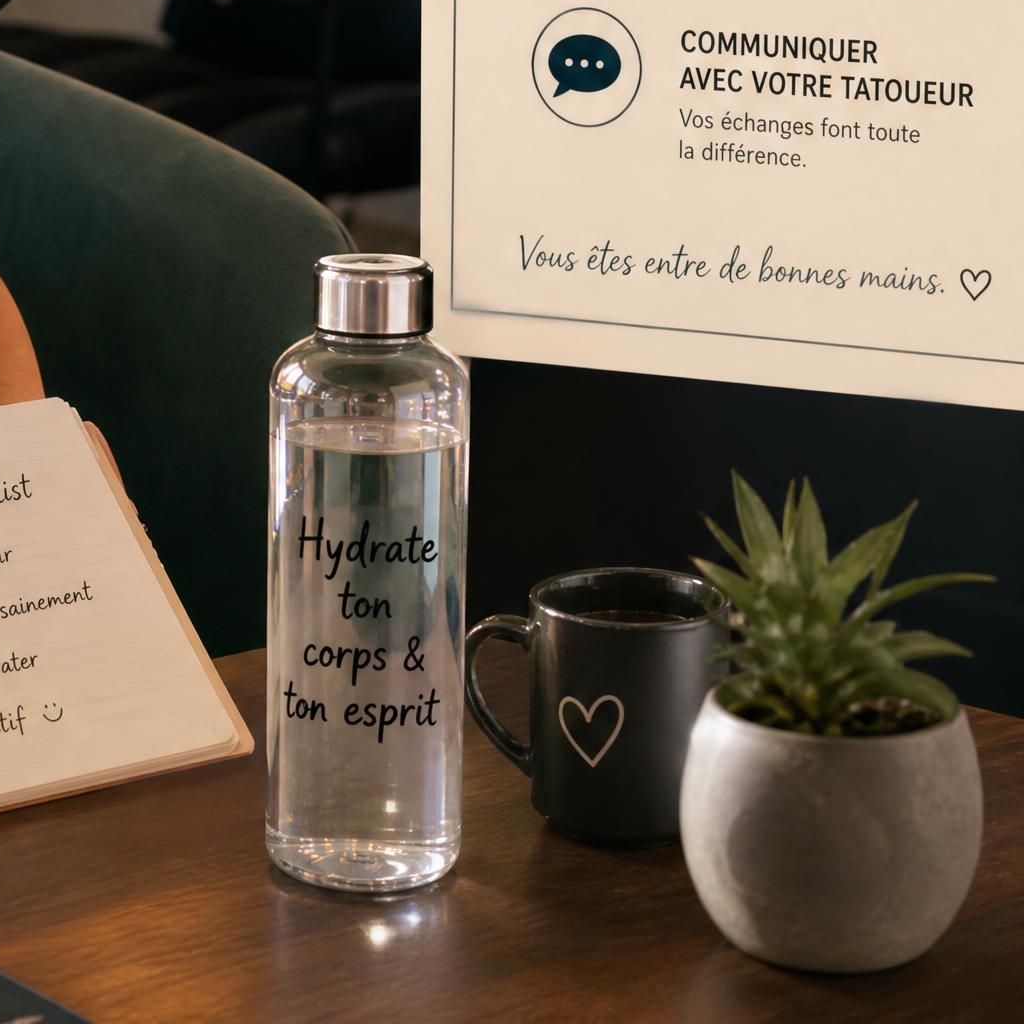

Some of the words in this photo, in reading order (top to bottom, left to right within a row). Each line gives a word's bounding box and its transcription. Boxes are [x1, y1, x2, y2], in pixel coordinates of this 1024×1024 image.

[680, 29, 878, 65] COMMUNIQUER
[679, 66, 743, 93] AVEC
[751, 70, 833, 99] VOTRE
[840, 75, 974, 108] TATOUEUR
[679, 107, 714, 130] Vos
[720, 110, 814, 140] échanges
[820, 116, 861, 140] font
[867, 122, 921, 144] toute
[679, 139, 695, 160] la
[701, 141, 807, 168] différence.
[519, 234, 579, 272] Vous
[586, 239, 636, 276] êtes
[644, 243, 712, 280] entre
[719, 244, 752, 284] de
[758, 247, 850, 290] bonnes
[859, 269, 945, 296] mains.
[297, 515, 439, 580] Hydrate
[0, 580, 94, 620] sainement
[337, 582, 393, 621] ton
[303, 643, 387, 687] corps
[403, 636, 425, 672] &
[283, 680, 329, 723] ton
[343, 687, 441, 745] esprit
